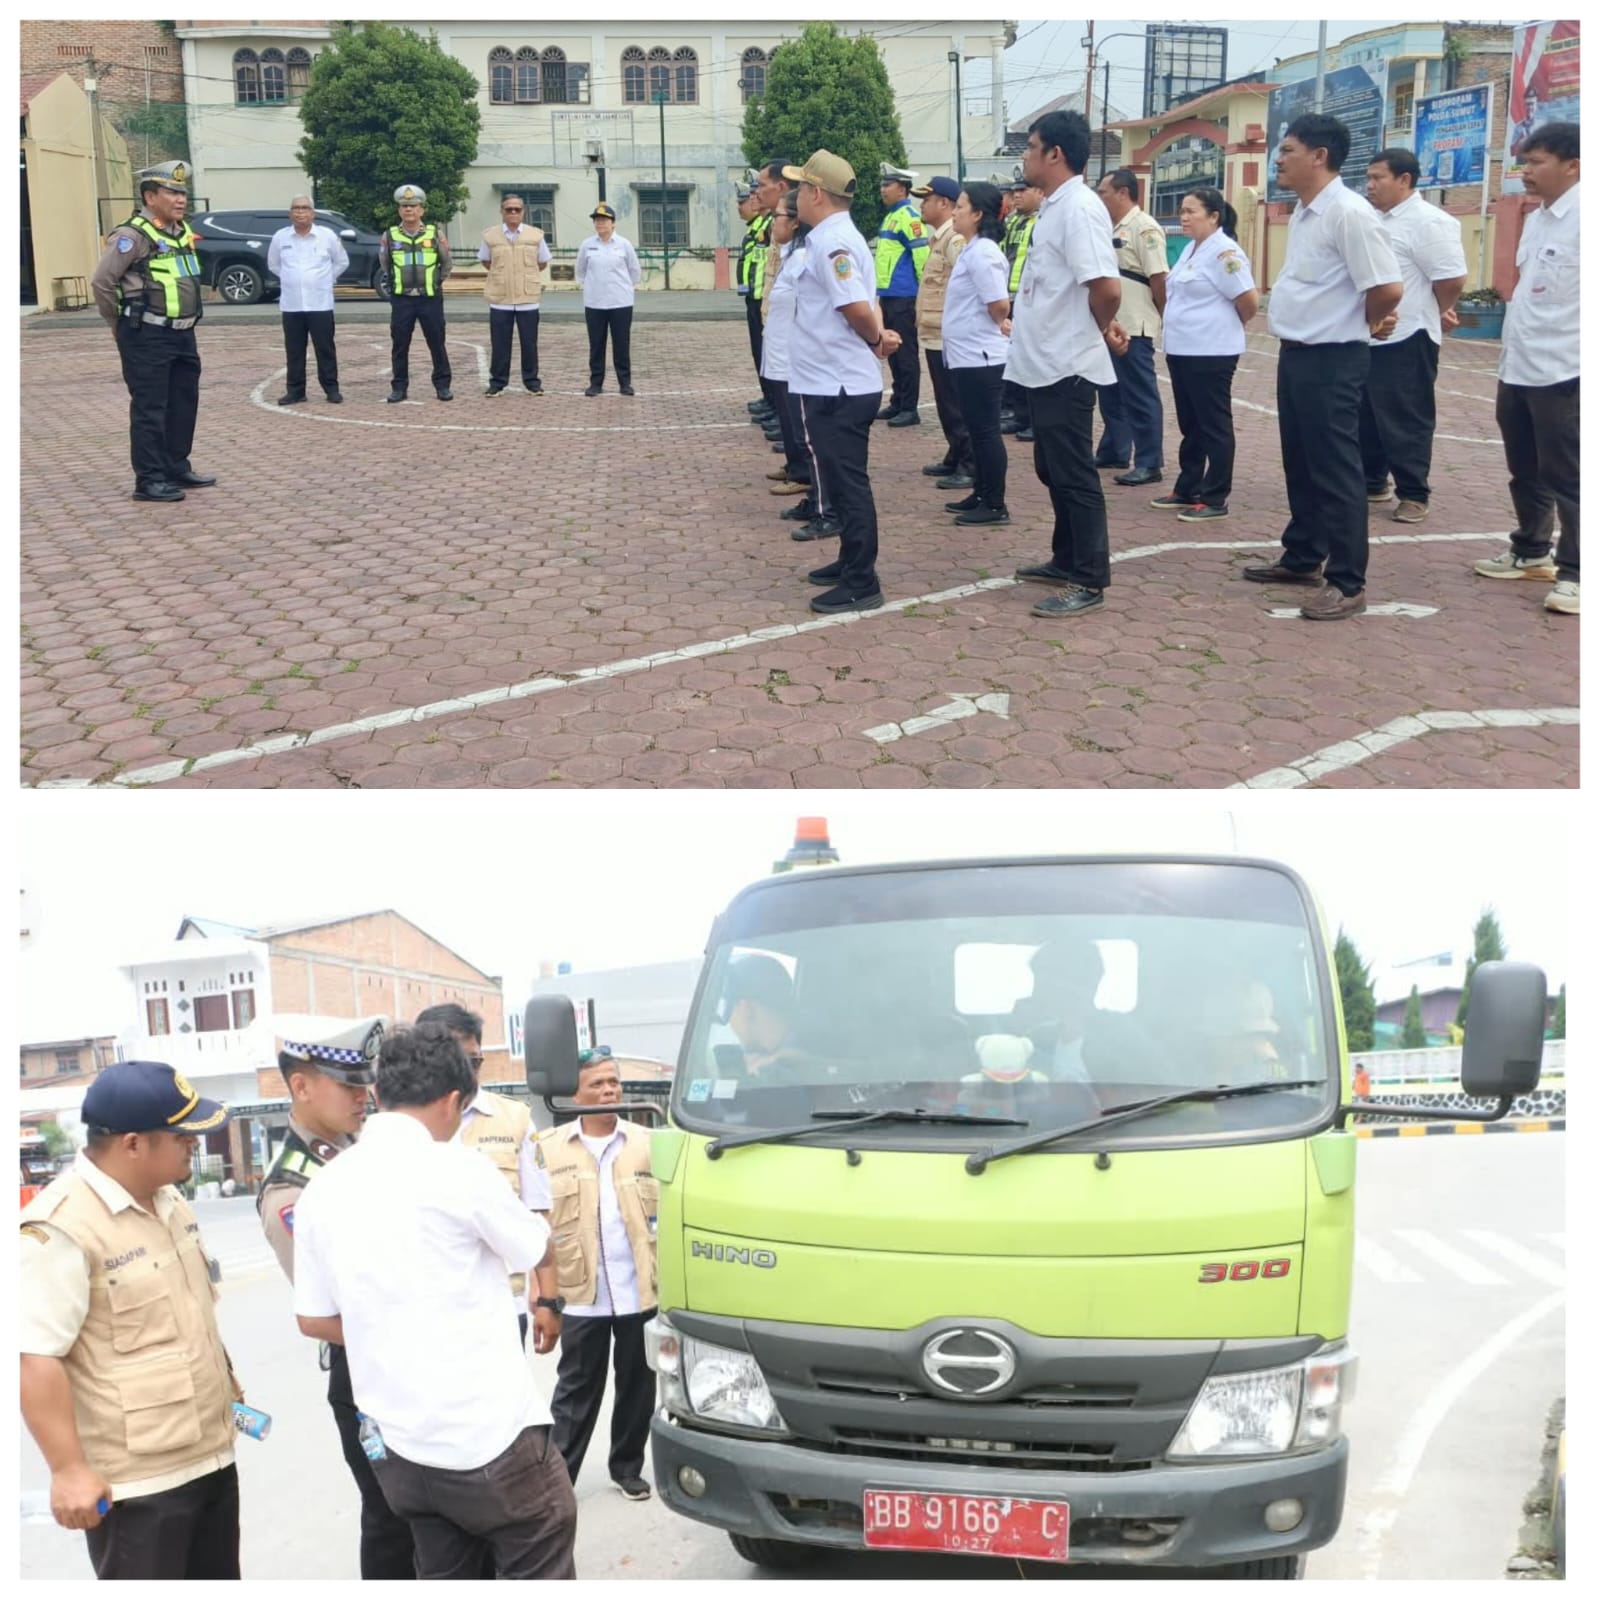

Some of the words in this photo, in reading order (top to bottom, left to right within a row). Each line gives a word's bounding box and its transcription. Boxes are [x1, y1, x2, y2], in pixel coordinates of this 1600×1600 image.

[692, 1240, 777, 1269] HINO
[1198, 1258, 1291, 1284] 300
[874, 1495, 910, 1528] BB
[924, 1497, 999, 1534] 9166
[1042, 1506, 1059, 1539] C
